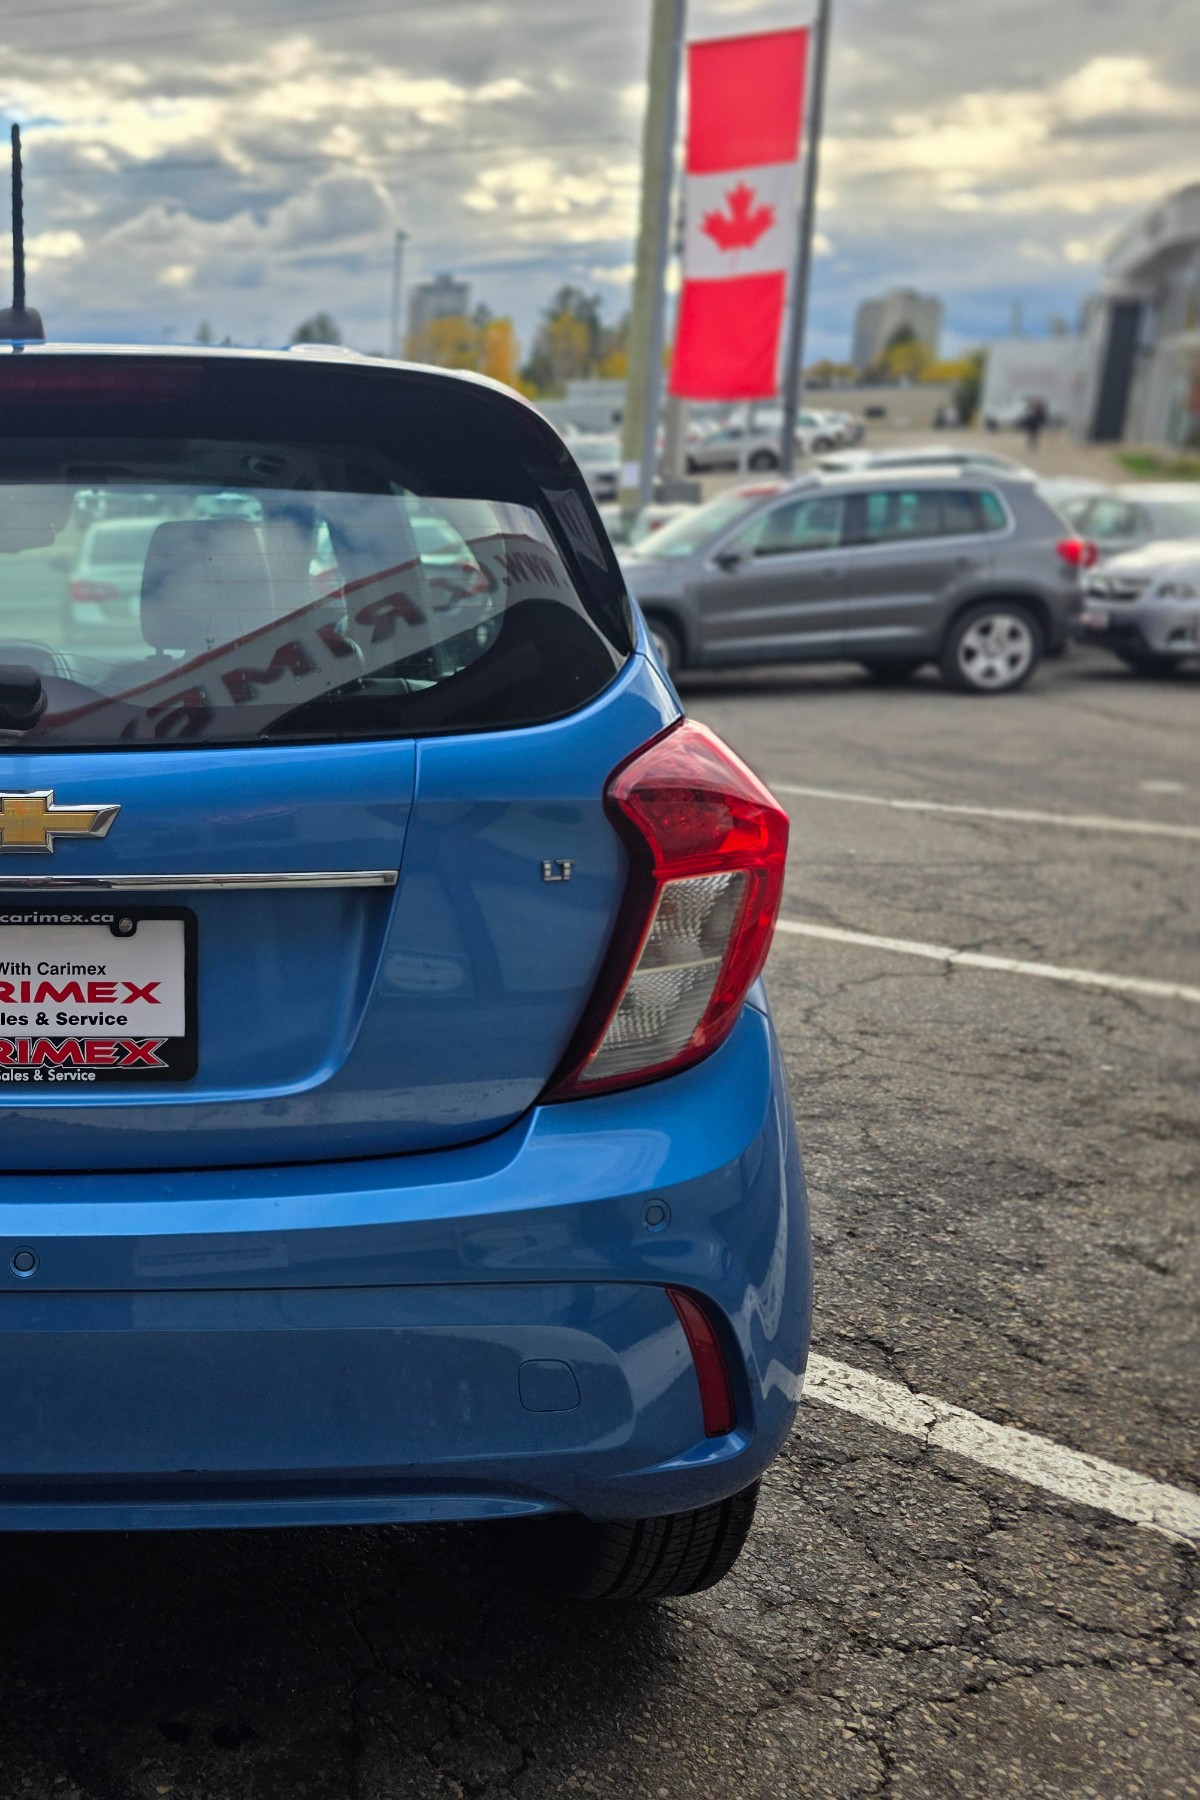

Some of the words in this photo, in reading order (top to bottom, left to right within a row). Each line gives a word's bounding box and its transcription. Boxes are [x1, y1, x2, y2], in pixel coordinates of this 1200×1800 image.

[543, 859, 576, 881] LT
[37, 962, 107, 976] Carimex
[35, 1012, 50, 1026] &
[55, 1011, 128, 1026] Service
[33, 1069, 44, 1081] &
[48, 1068, 96, 1081] Service
